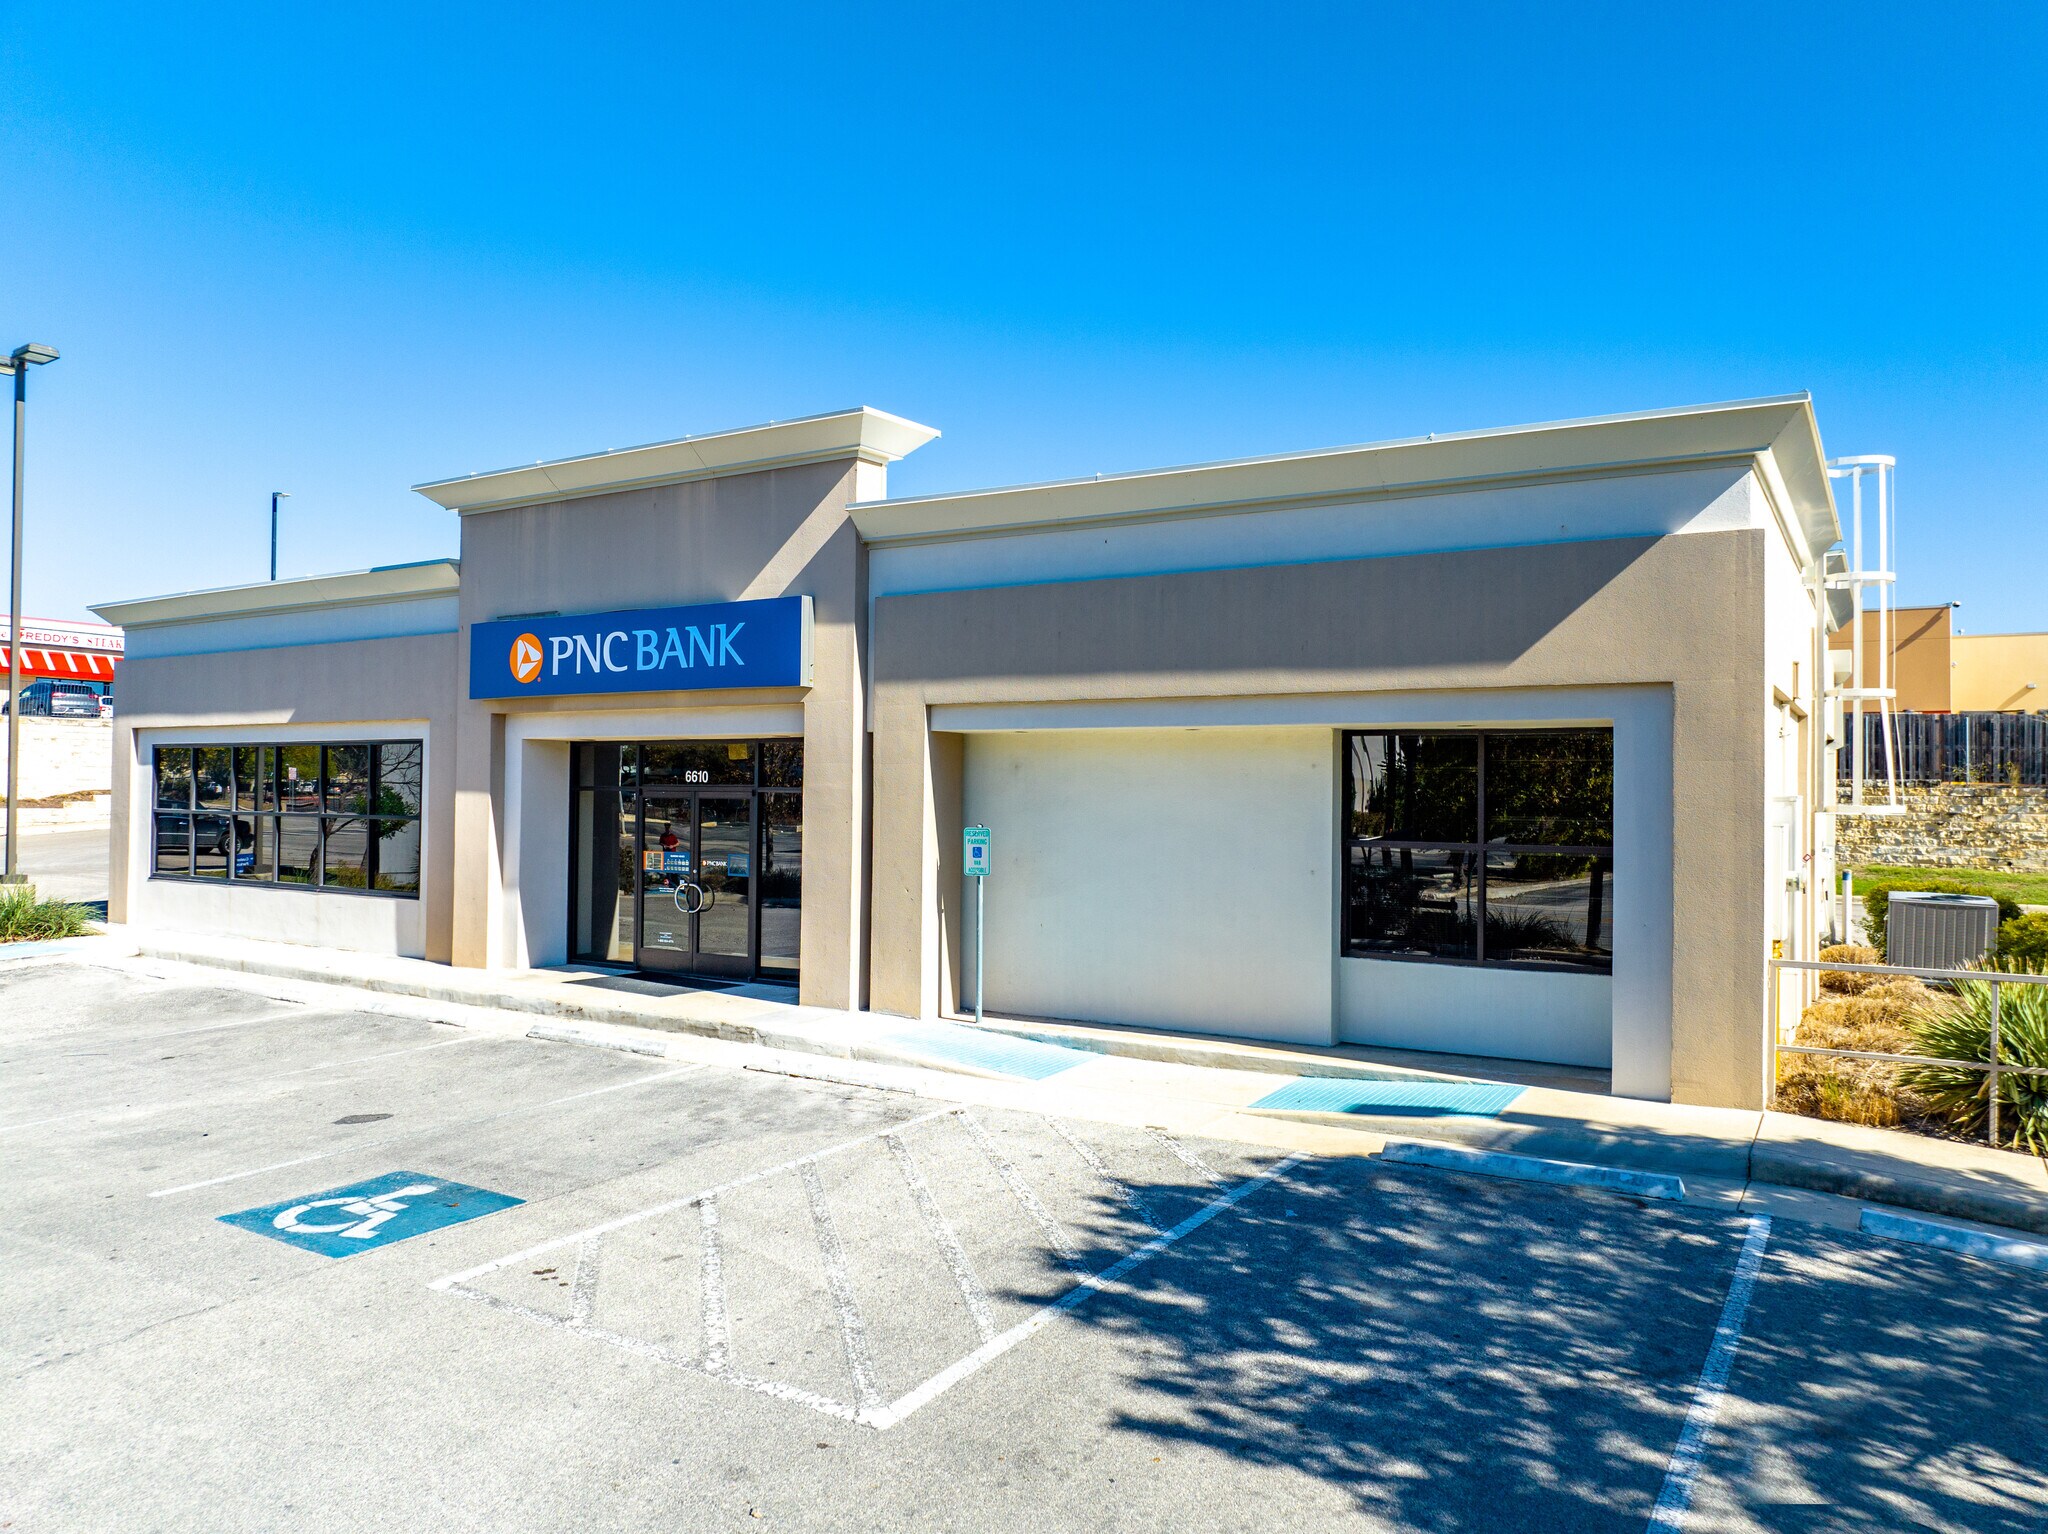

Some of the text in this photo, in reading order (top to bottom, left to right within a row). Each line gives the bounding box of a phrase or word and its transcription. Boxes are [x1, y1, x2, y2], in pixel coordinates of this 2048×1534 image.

[549, 622, 746, 676] PNC BANK
[685, 770, 709, 783] 6610
